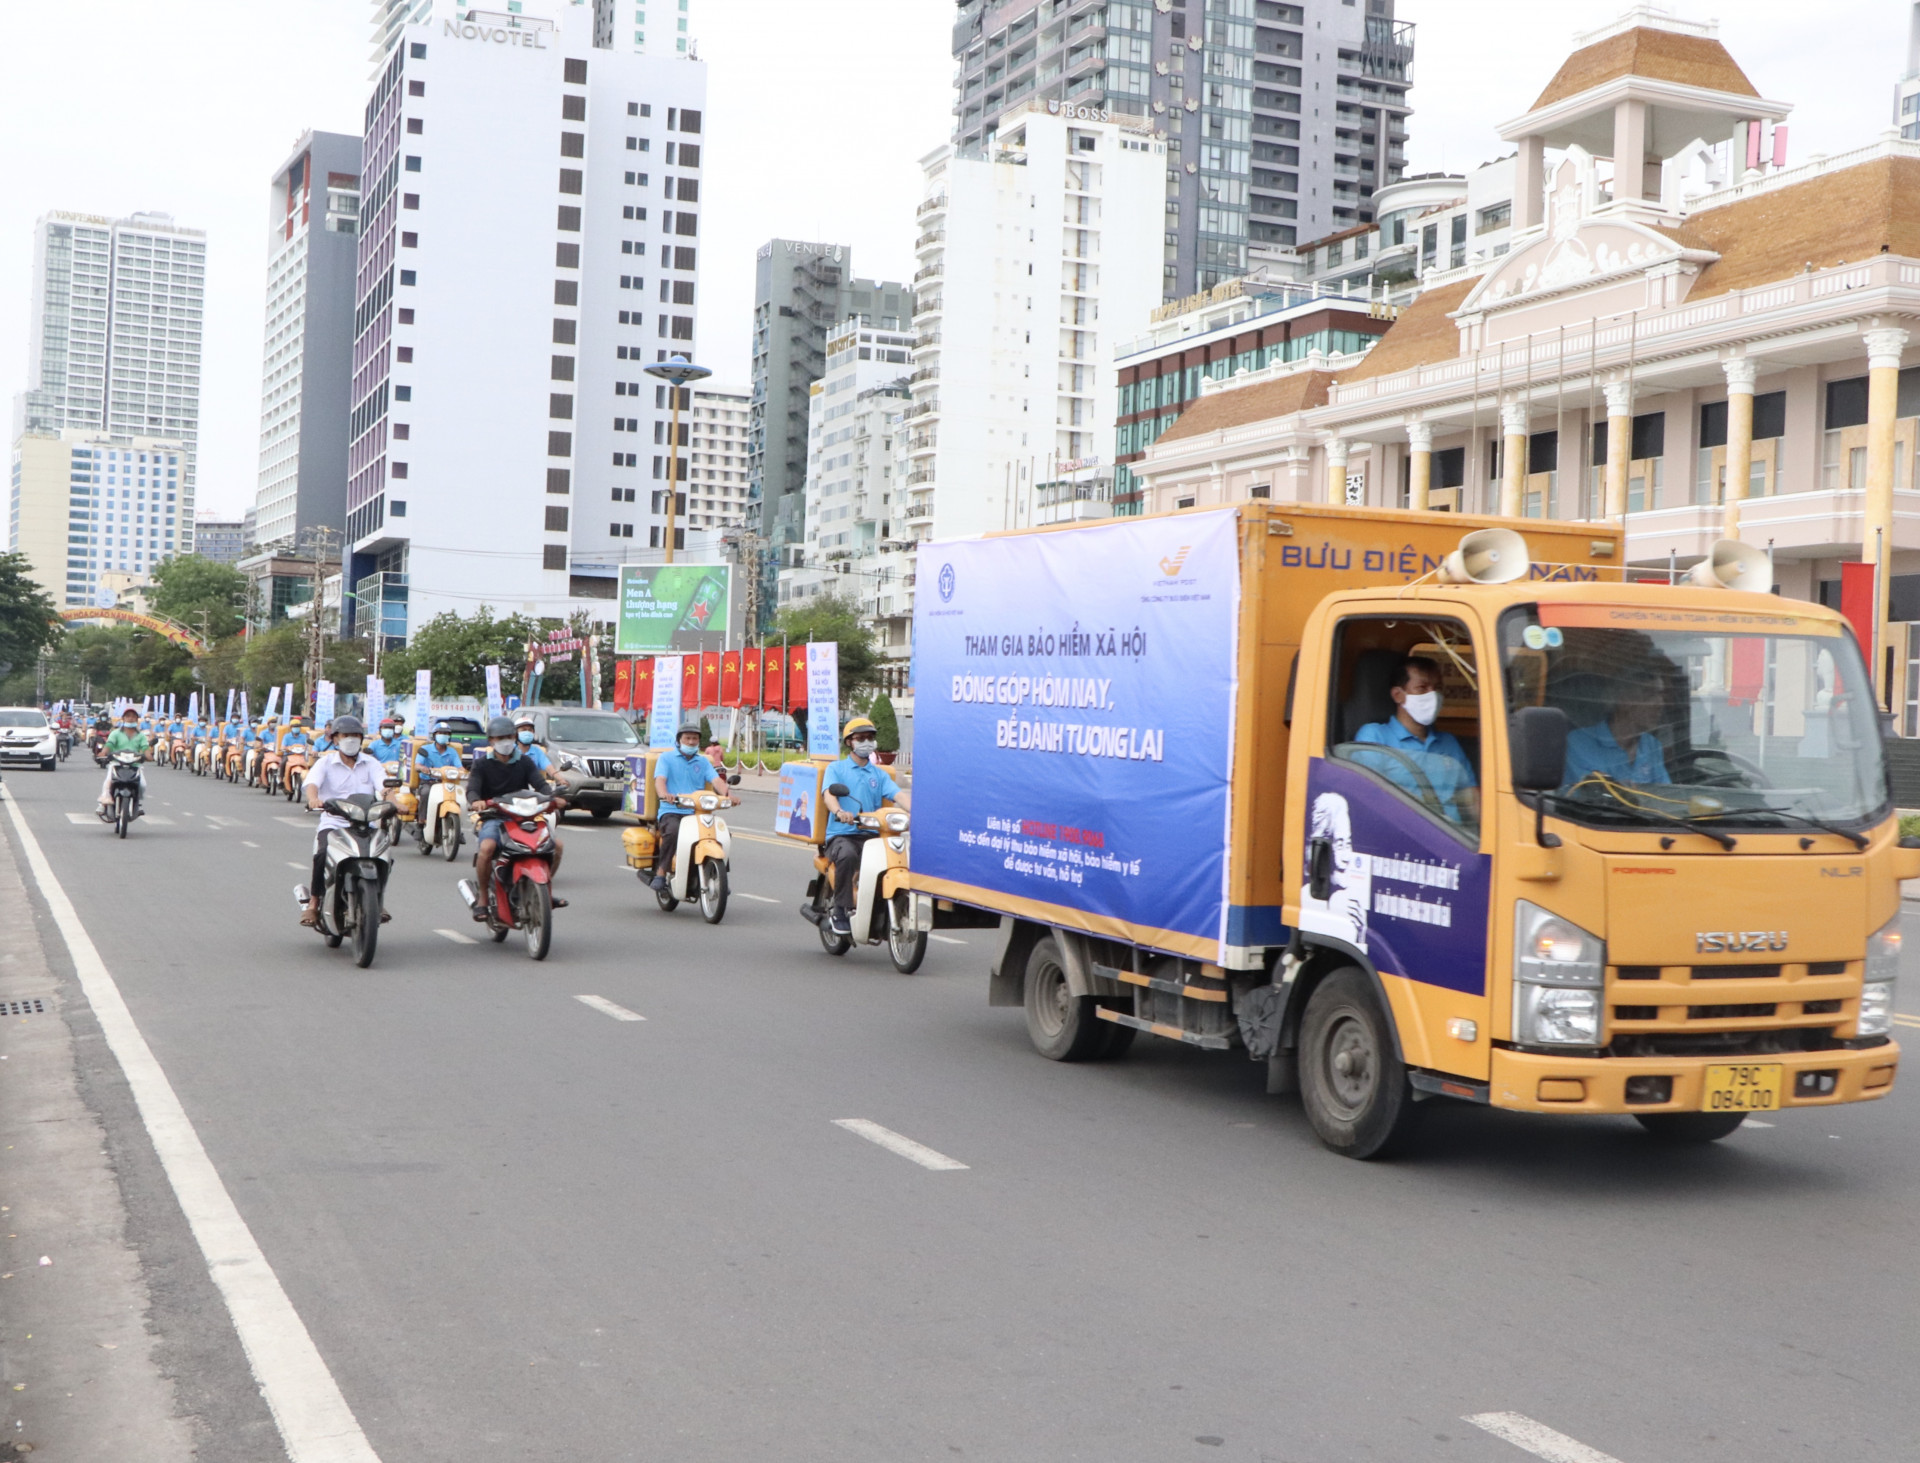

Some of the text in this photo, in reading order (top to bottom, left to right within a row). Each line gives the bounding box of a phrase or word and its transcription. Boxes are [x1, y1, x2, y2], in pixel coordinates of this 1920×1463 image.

[444, 19, 547, 50] NOVOTEL
[1065, 104, 1108, 122] BOSS
[785, 242, 832, 257] VENUE
[1364, 544, 1444, 580] ĐIỆN
[626, 588, 644, 598] Men
[965, 621, 1146, 663] THAM GIA BẢO HIỂM XÃ HỘI
[952, 670, 1115, 712] ĐÓNG GÓP HÔM NAY,
[997, 708, 1018, 748] ĐỂ
[1020, 716, 1064, 752] DÀNH
[1130, 728, 1164, 762] LAI
[987, 816, 1001, 830] Liên
[1002, 818, 1011, 836] hệ
[1012, 819, 1022, 834] số
[1022, 820, 1057, 840] HOTLINE
[959, 830, 1142, 876] hoặc đến đại lý thu bảo hiểm xã hội, bảo hiểm y tế
[1004, 853, 1014, 870] để
[1015, 858, 1034, 876] được
[1058, 865, 1070, 882] hỗ
[1820, 866, 1863, 878] NLR
[1696, 930, 1788, 953] ISUZU
[1728, 1067, 1760, 1086] 79C
[1712, 1090, 1773, 1109] 084.00
